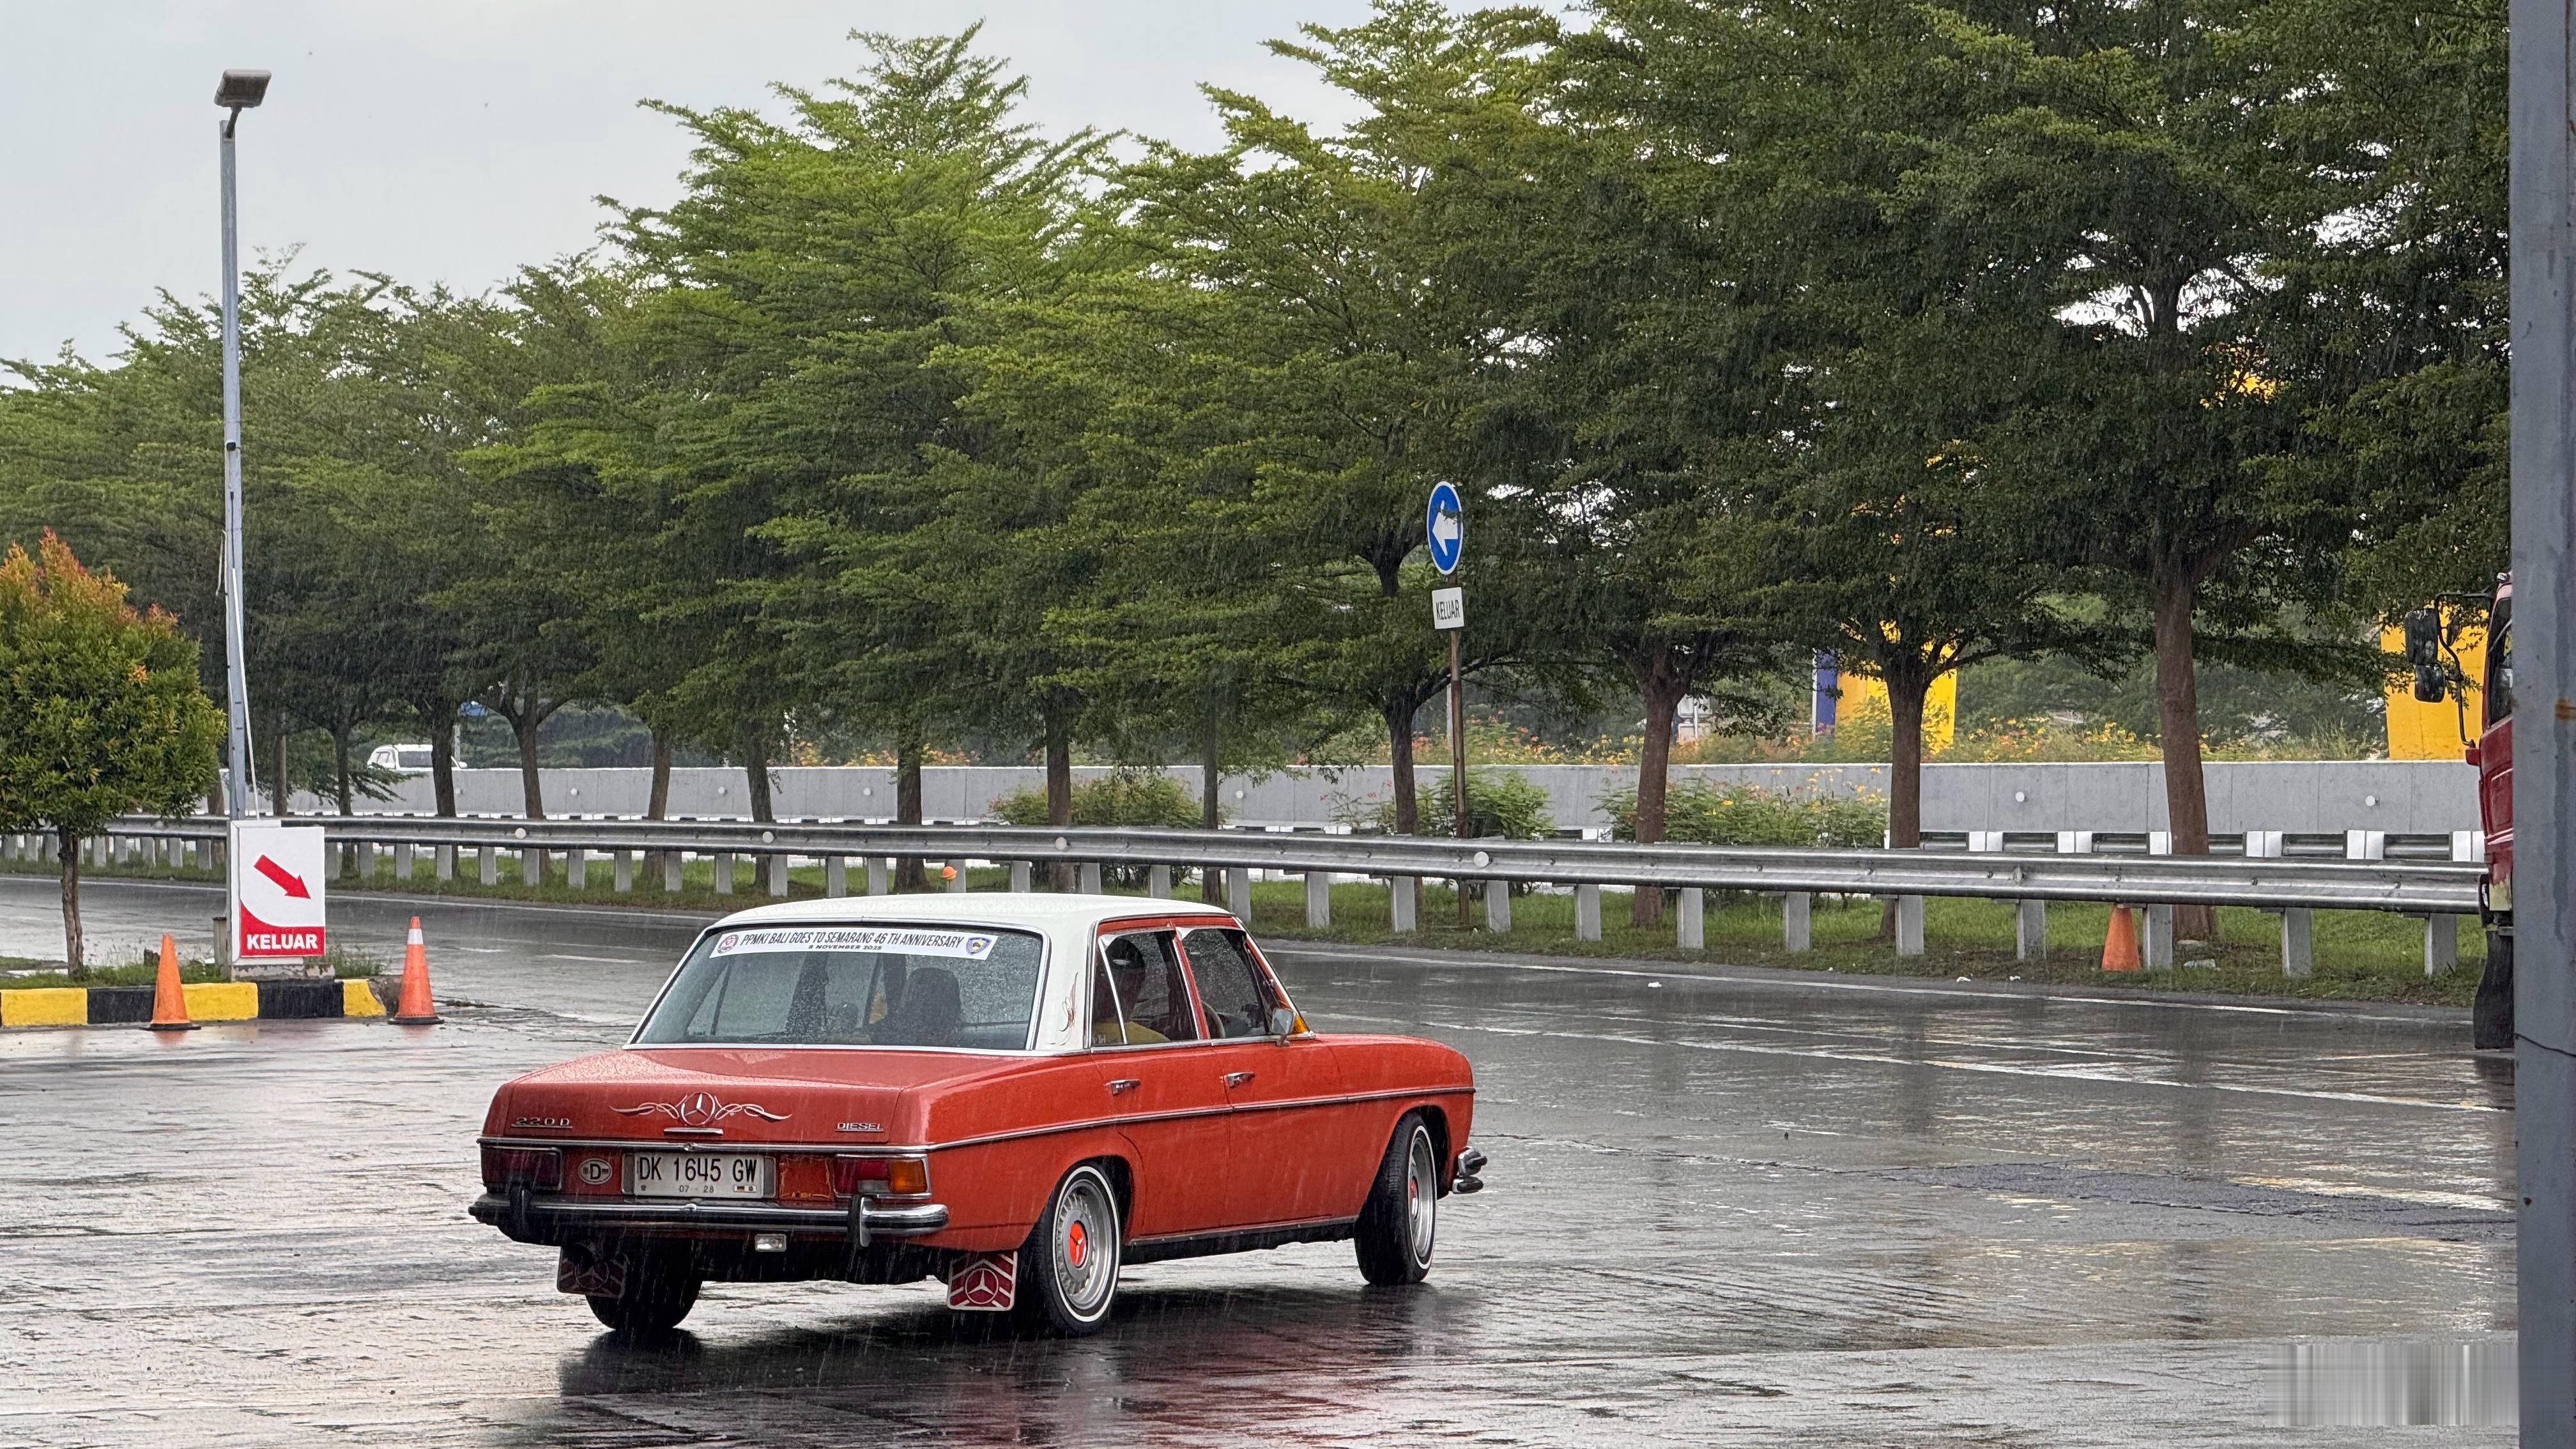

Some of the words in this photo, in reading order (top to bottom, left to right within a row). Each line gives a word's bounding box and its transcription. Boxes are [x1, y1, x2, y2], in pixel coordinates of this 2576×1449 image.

[1436, 599, 1460, 620] KELUAR
[247, 933, 318, 950] KELUAR
[740, 933, 769, 946] PPMKI
[768, 933, 788, 944] BALI
[789, 932, 813, 944] GOES
[813, 932, 826, 943] TO
[825, 931, 874, 944] SEMARANG
[873, 933, 887, 944] 46
[887, 933, 900, 945] TH
[900, 934, 965, 948] ANNIVERSARY
[590, 1163, 601, 1179] D
[640, 1157, 662, 1181] DK
[674, 1158, 721, 1182] 1645
[733, 1159, 757, 1183] GW
